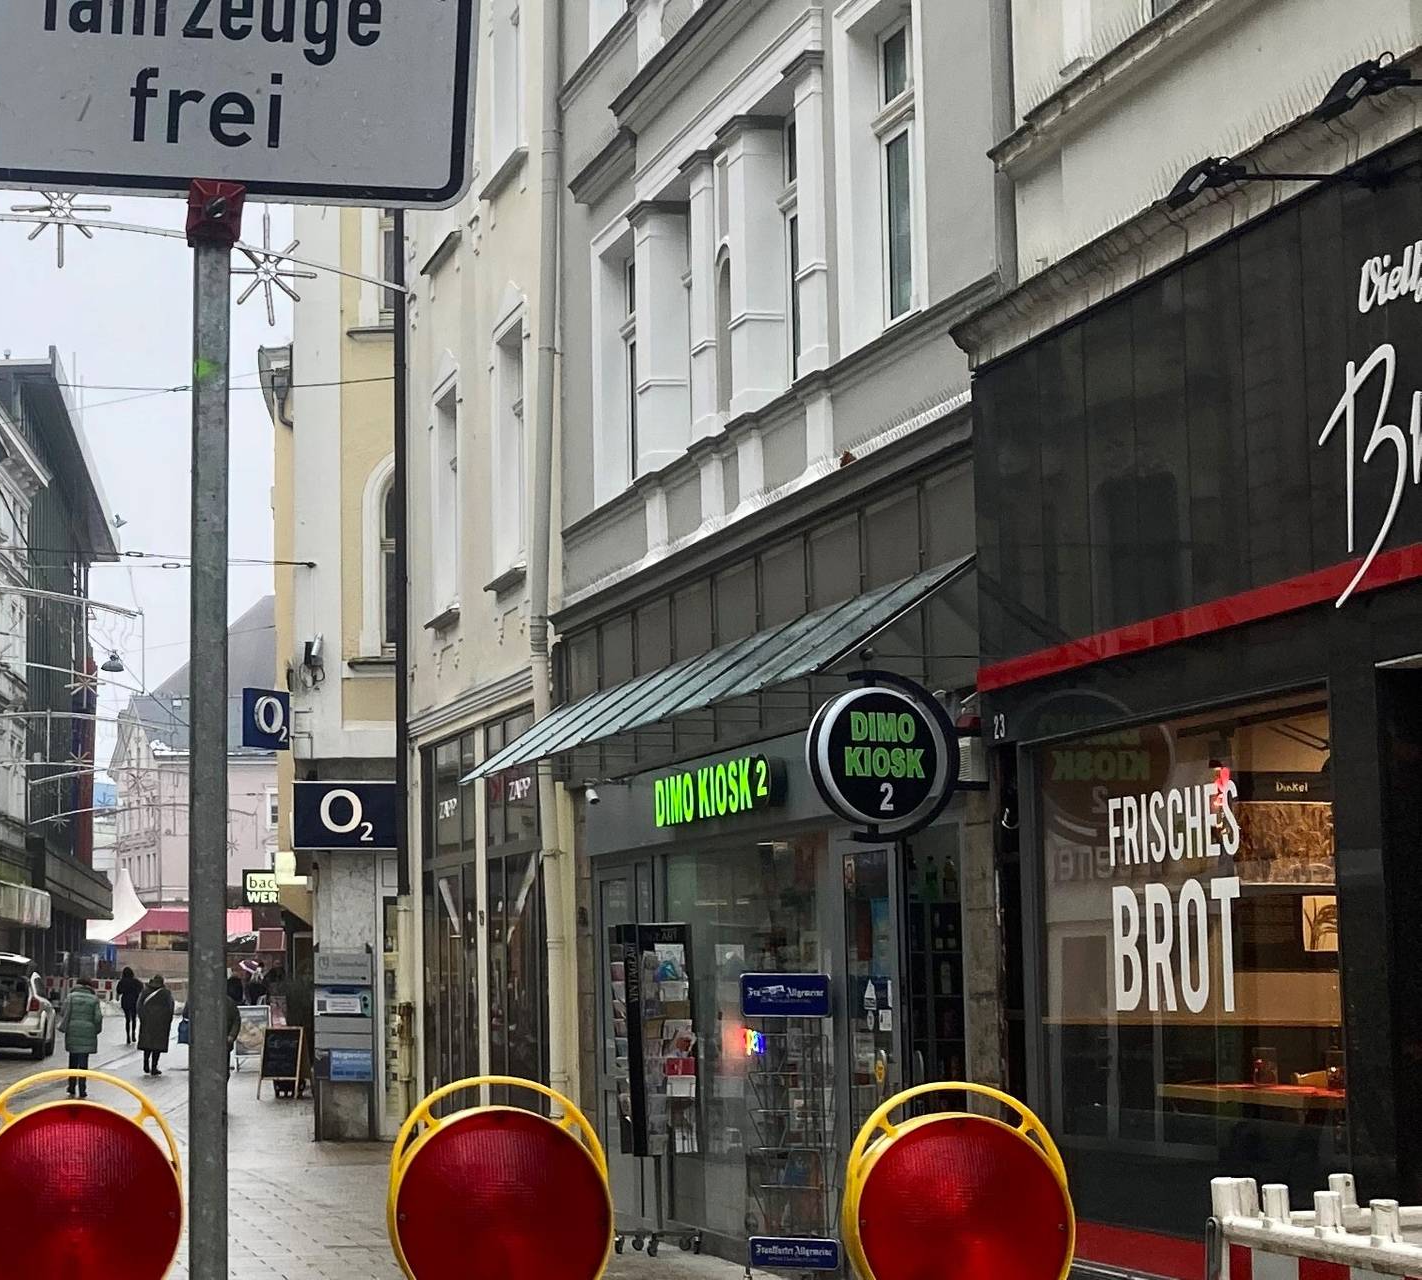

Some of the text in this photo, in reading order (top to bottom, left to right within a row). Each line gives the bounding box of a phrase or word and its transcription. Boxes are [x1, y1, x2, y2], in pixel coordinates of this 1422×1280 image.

[130, 67, 283, 148] frei
[850, 711, 916, 743] DIMO
[993, 713, 1006, 740] 23
[844, 746, 926, 779] KIOSK
[654, 757, 768, 828] DIMO KIOSK 2
[880, 782, 894, 811] 2
[1108, 779, 1241, 867] FRISCHES
[1112, 877, 1241, 1013] BROT
